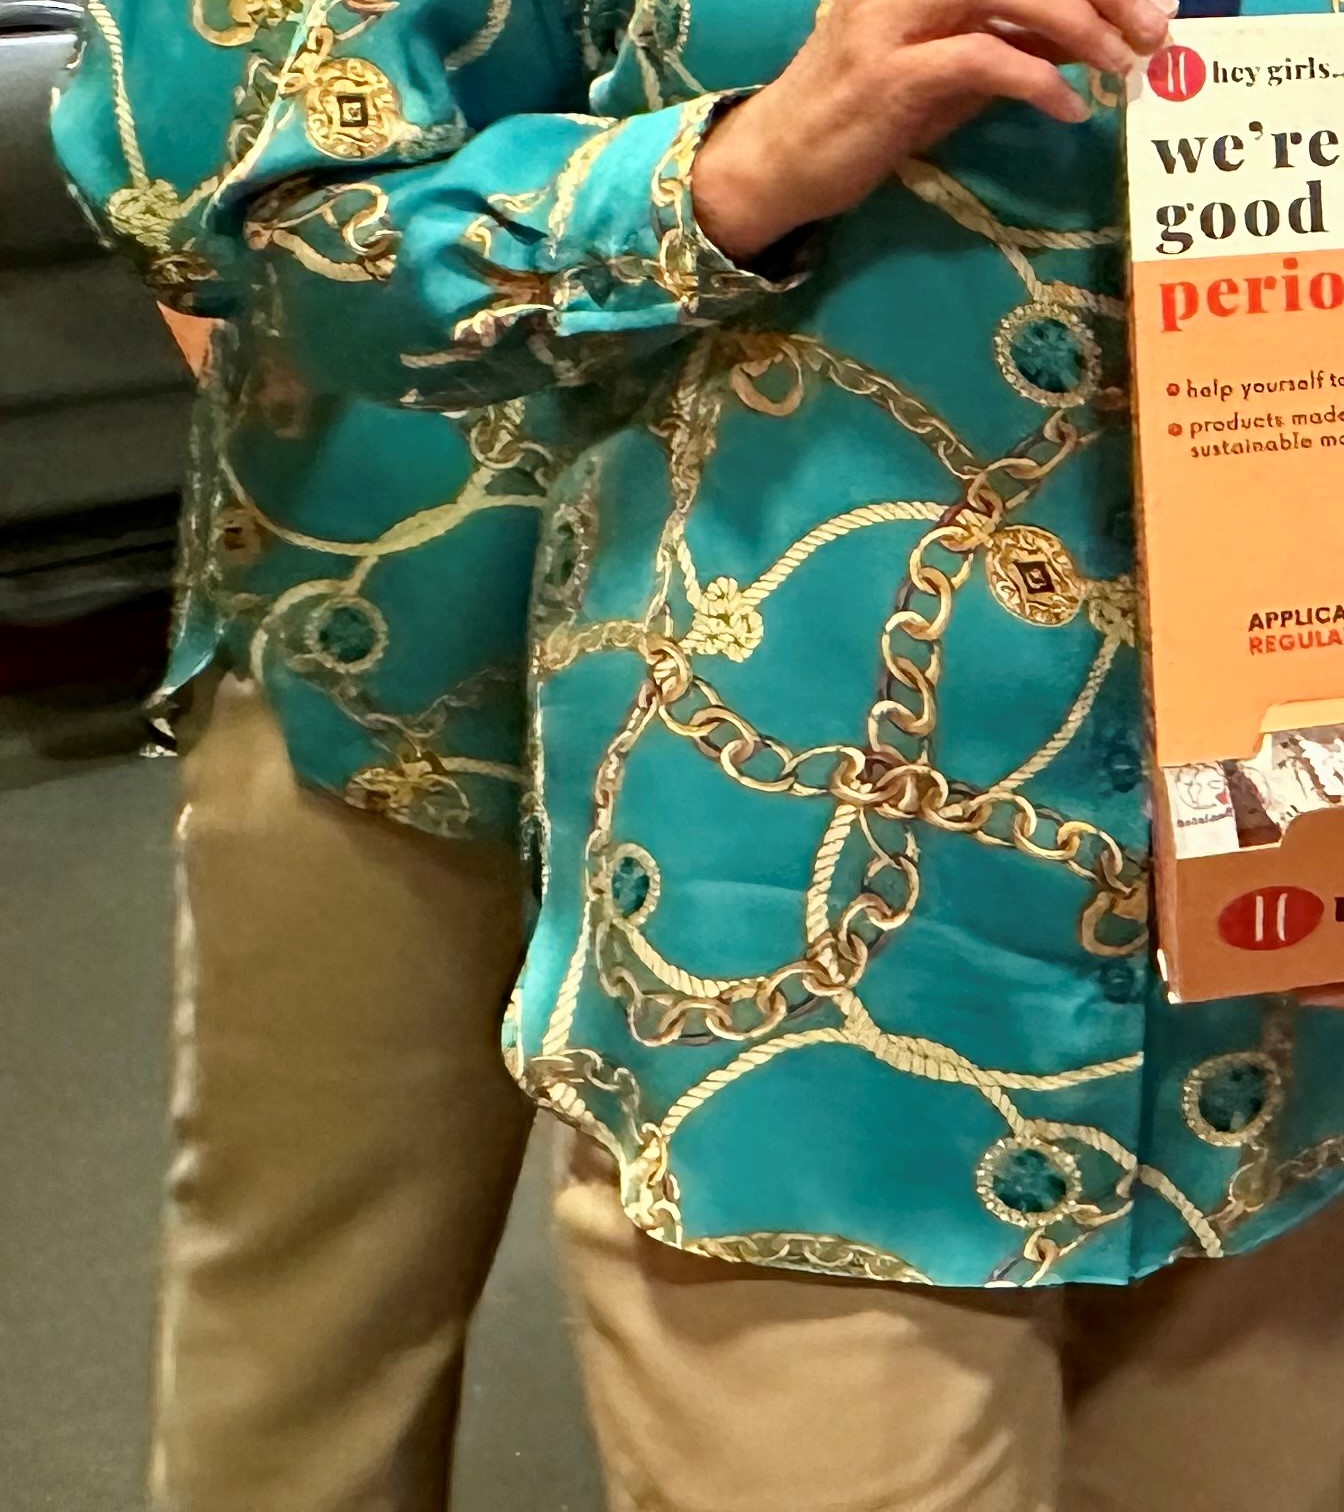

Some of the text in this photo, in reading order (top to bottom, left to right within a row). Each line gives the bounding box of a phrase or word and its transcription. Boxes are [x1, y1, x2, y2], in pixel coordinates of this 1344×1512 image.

[1212, 61, 1260, 87] hey
[1151, 121, 1340, 174] we're
[1156, 180, 1328, 255] good
[1187, 378, 1233, 401] help
[1241, 370, 1325, 399] yourself
[1190, 412, 1285, 437] products
[1190, 432, 1313, 458] sustainable
